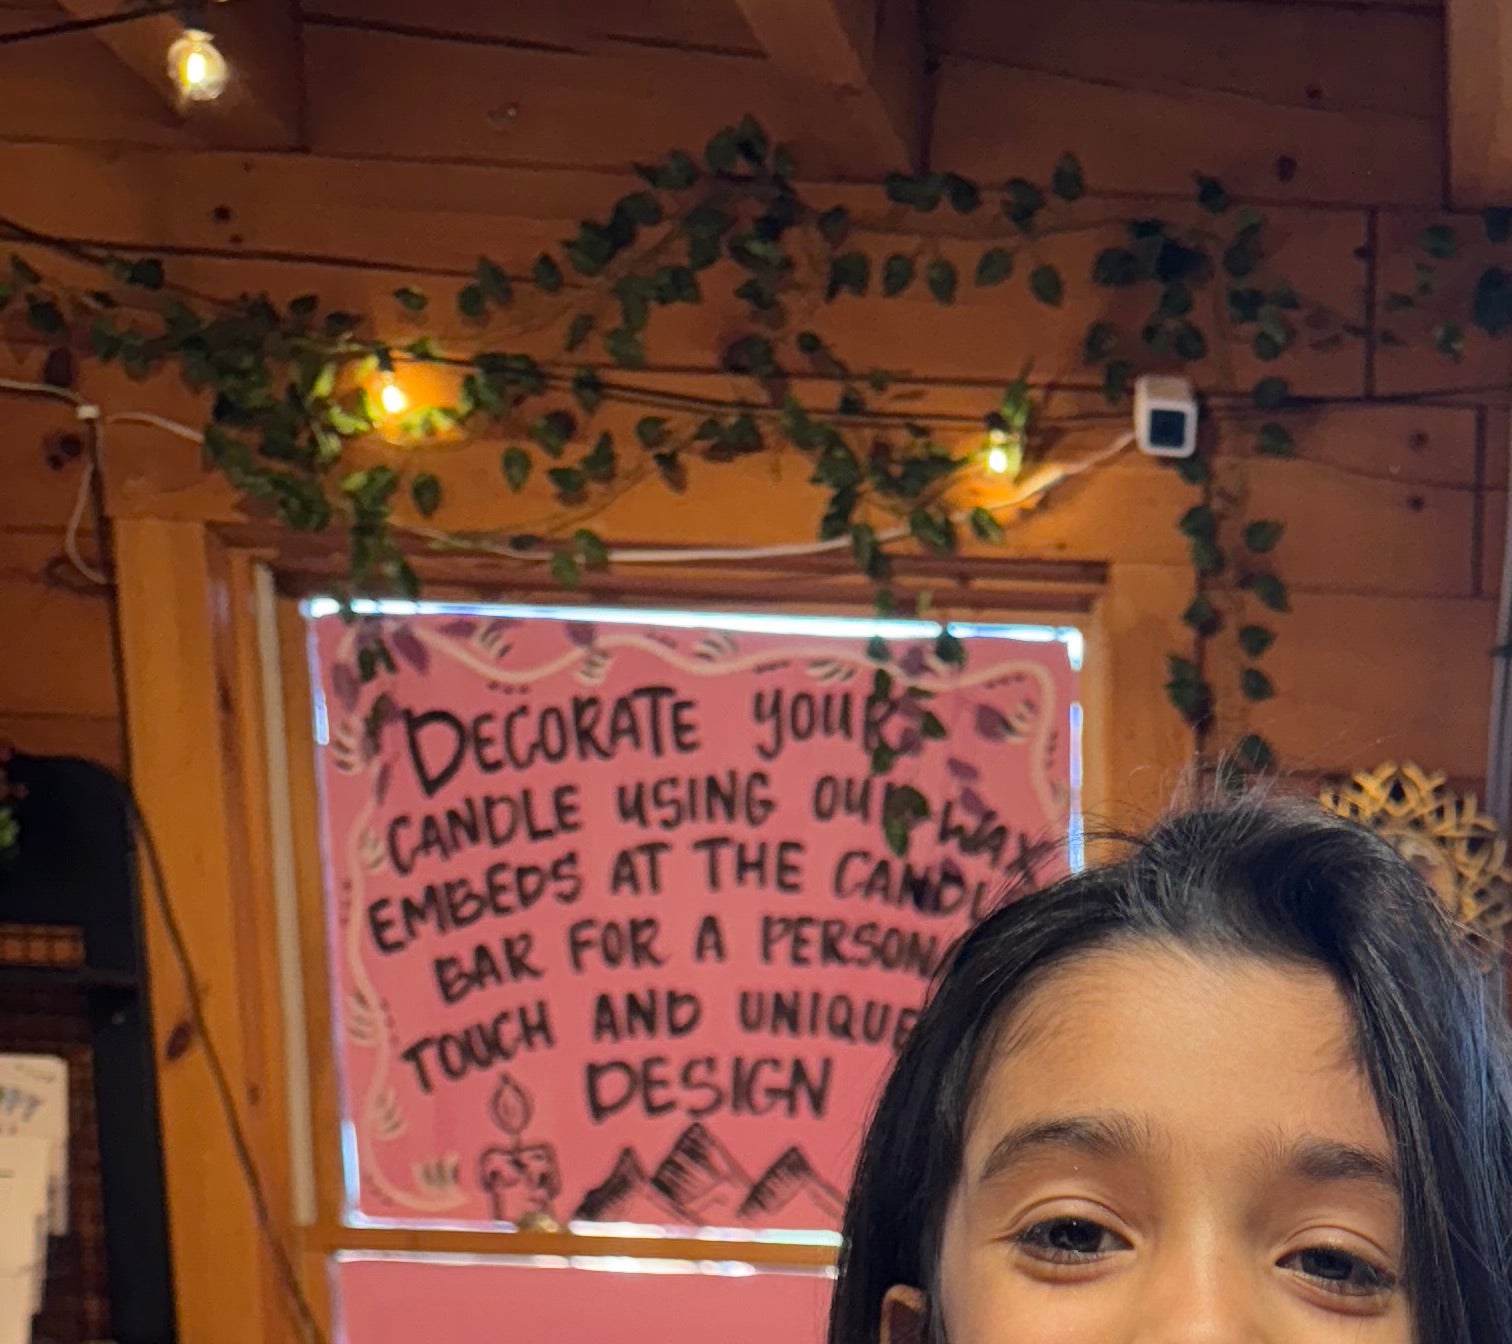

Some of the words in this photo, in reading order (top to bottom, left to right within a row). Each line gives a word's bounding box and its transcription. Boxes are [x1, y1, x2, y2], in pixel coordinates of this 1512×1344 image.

[403, 686, 700, 797] DECORATE
[387, 784, 583, 877] CANDLE
[615, 769, 776, 831] USING
[812, 774, 918, 834] OU
[368, 852, 583, 955] EMBEDS
[611, 841, 671, 896] AT
[693, 835, 804, 893] THE
[434, 933, 544, 1006] BAR
[568, 917, 667, 974] FOR
[695, 914, 726, 963] A
[761, 914, 938, 979] PERSON
[401, 999, 555, 1094] TOUCH
[593, 990, 701, 1042] AND
[585, 1055, 833, 1122] DESIGN
